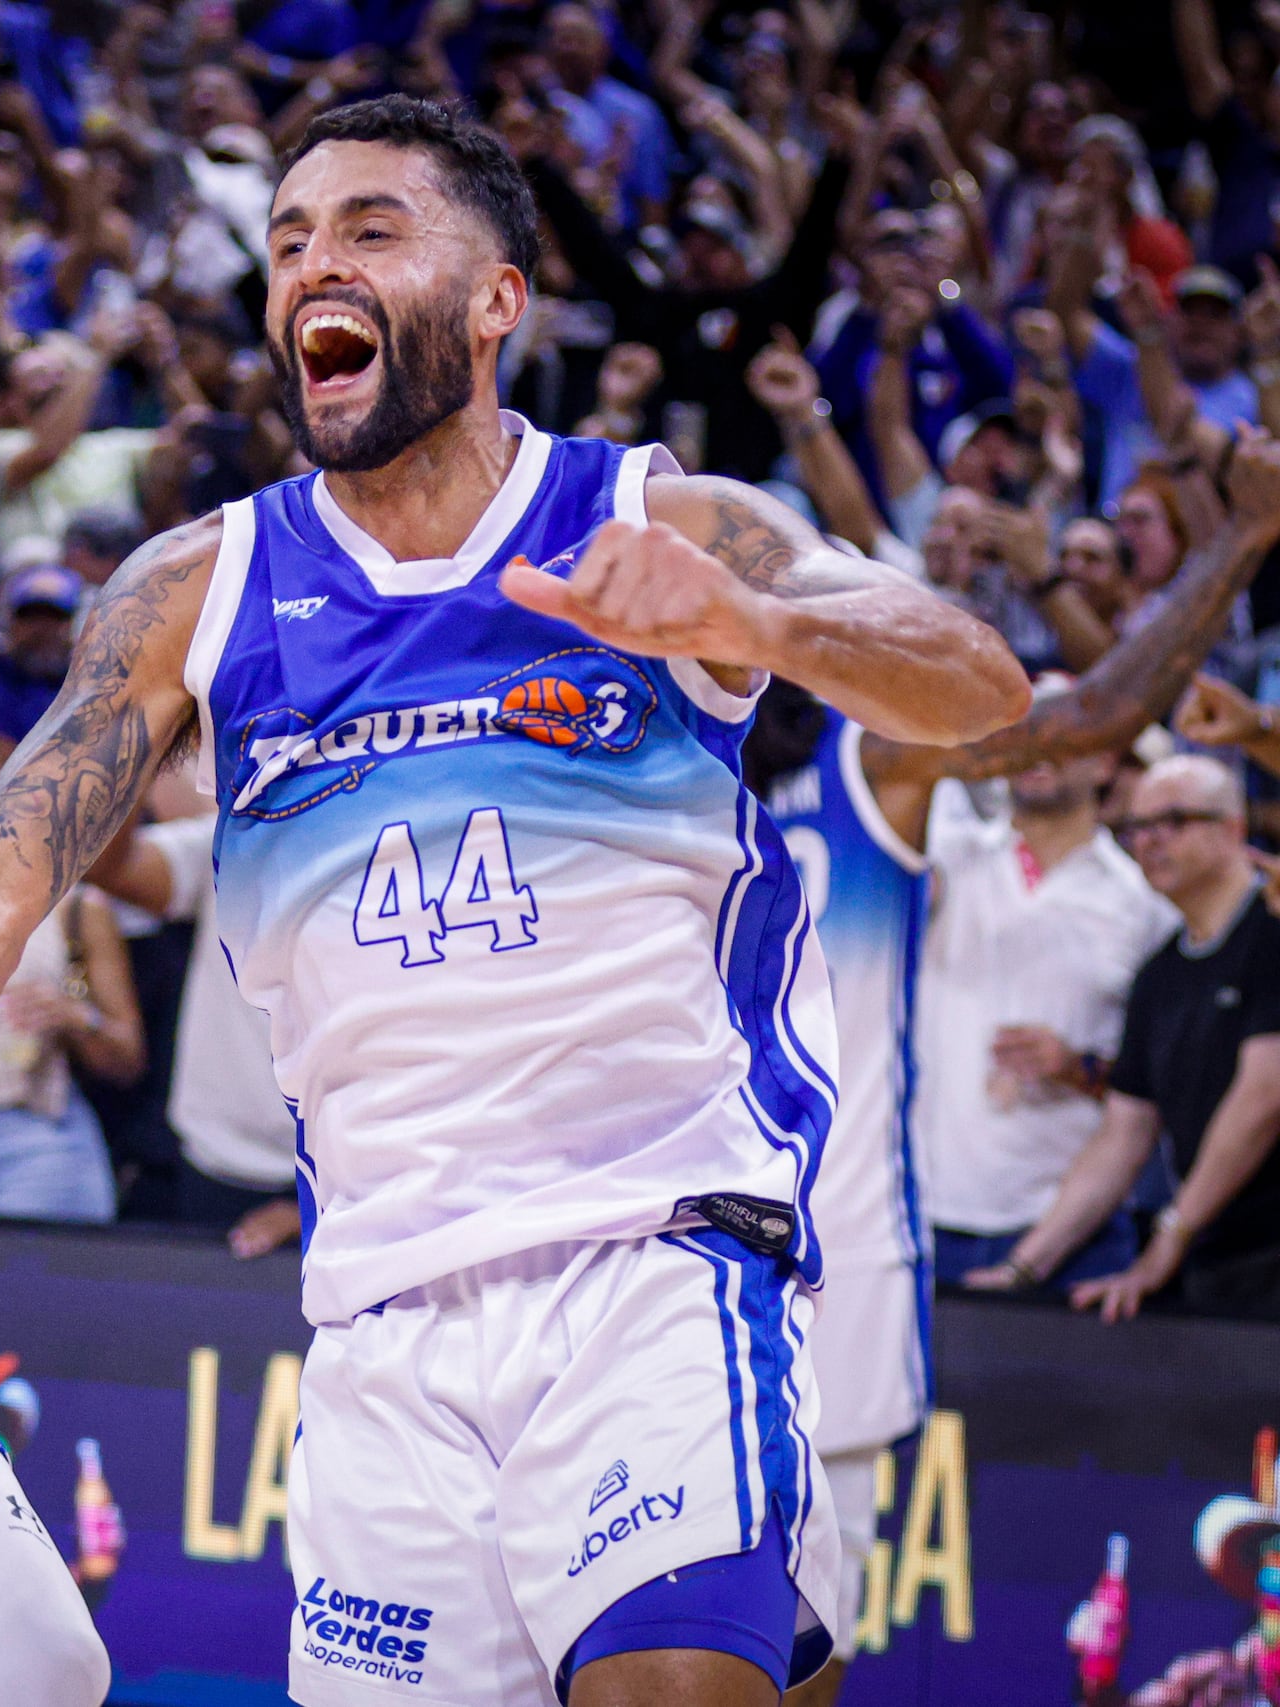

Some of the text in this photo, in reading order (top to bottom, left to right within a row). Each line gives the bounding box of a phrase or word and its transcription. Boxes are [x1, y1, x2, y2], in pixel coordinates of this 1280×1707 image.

[353, 806, 539, 968] 44
[300, 1604, 428, 1663] Verdes
[303, 1577, 434, 1631] Lomas
